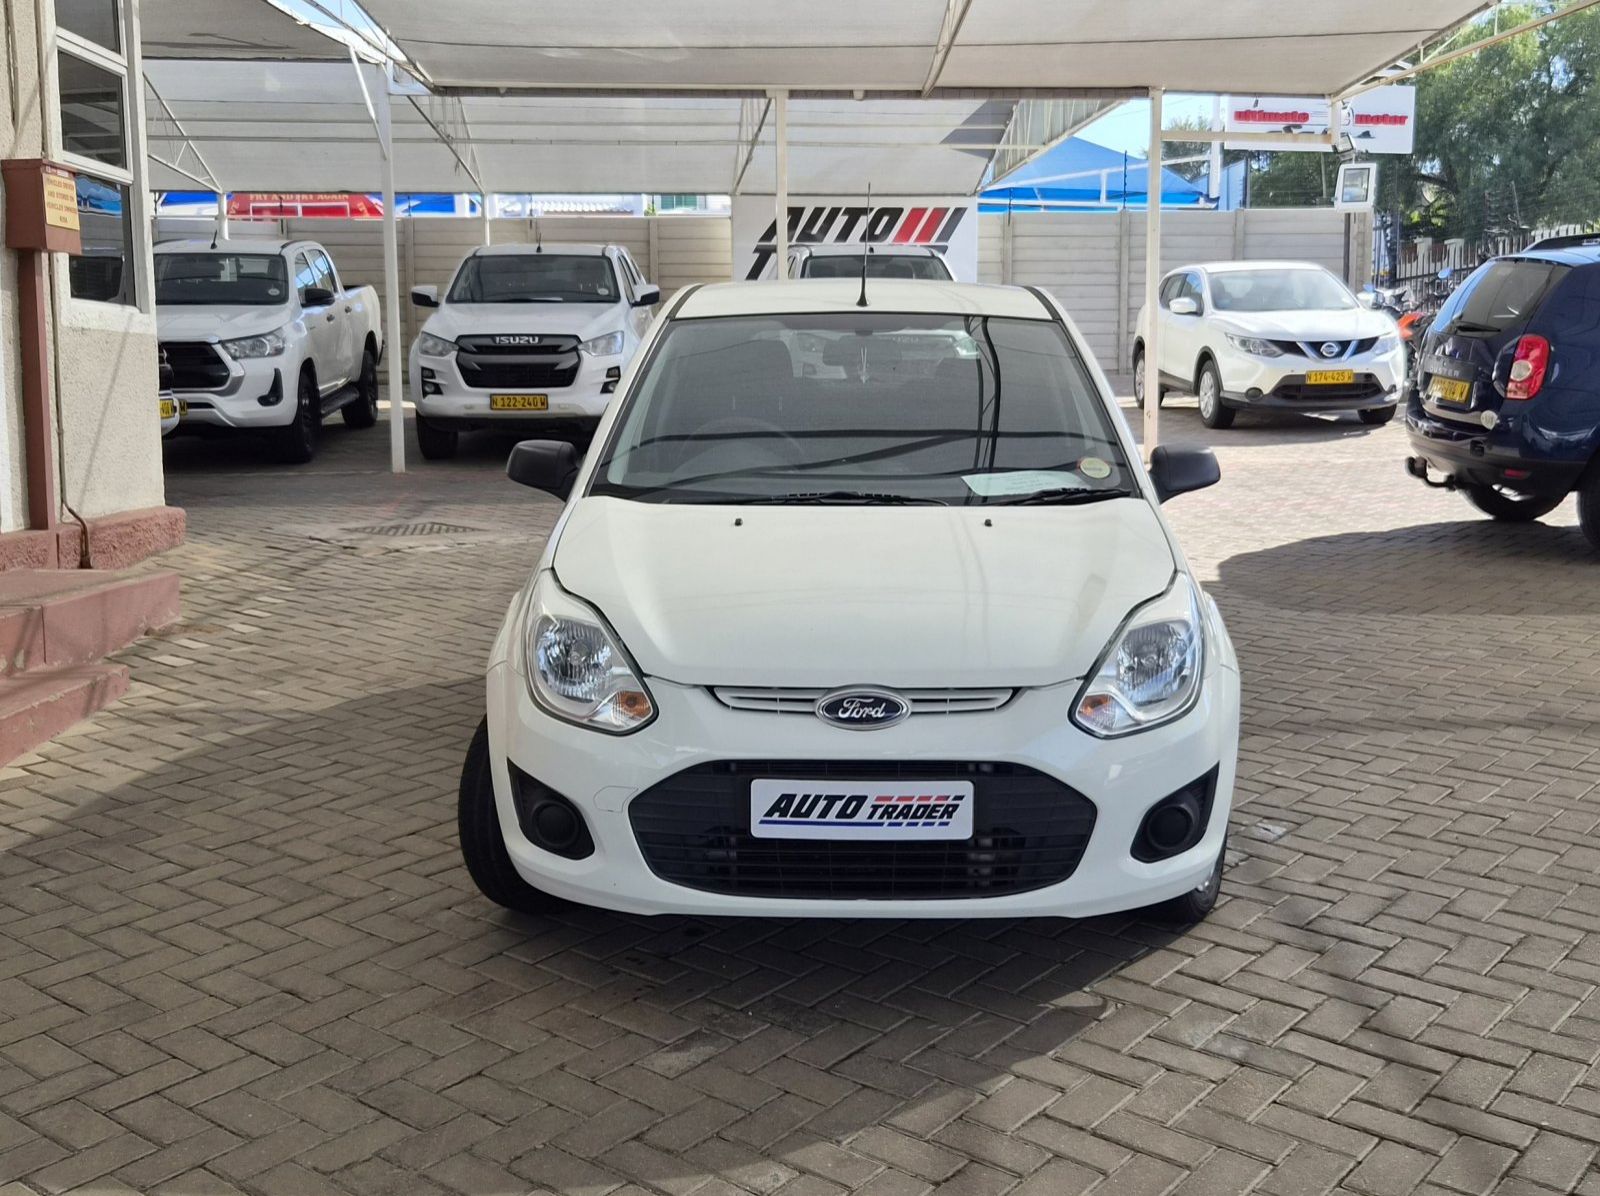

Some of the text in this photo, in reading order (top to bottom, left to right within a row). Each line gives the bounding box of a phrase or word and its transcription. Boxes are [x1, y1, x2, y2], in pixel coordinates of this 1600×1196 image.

[1234, 109, 1309, 123] ultimate
[1355, 113, 1408, 125] motor
[758, 206, 904, 243] AUTO
[496, 335, 539, 344] ISUZU
[1429, 367, 1460, 377] DUSTER
[492, 397, 546, 407] N 122-240 W
[838, 697, 886, 719] Ford
[763, 793, 960, 820] AUTO TRADER
